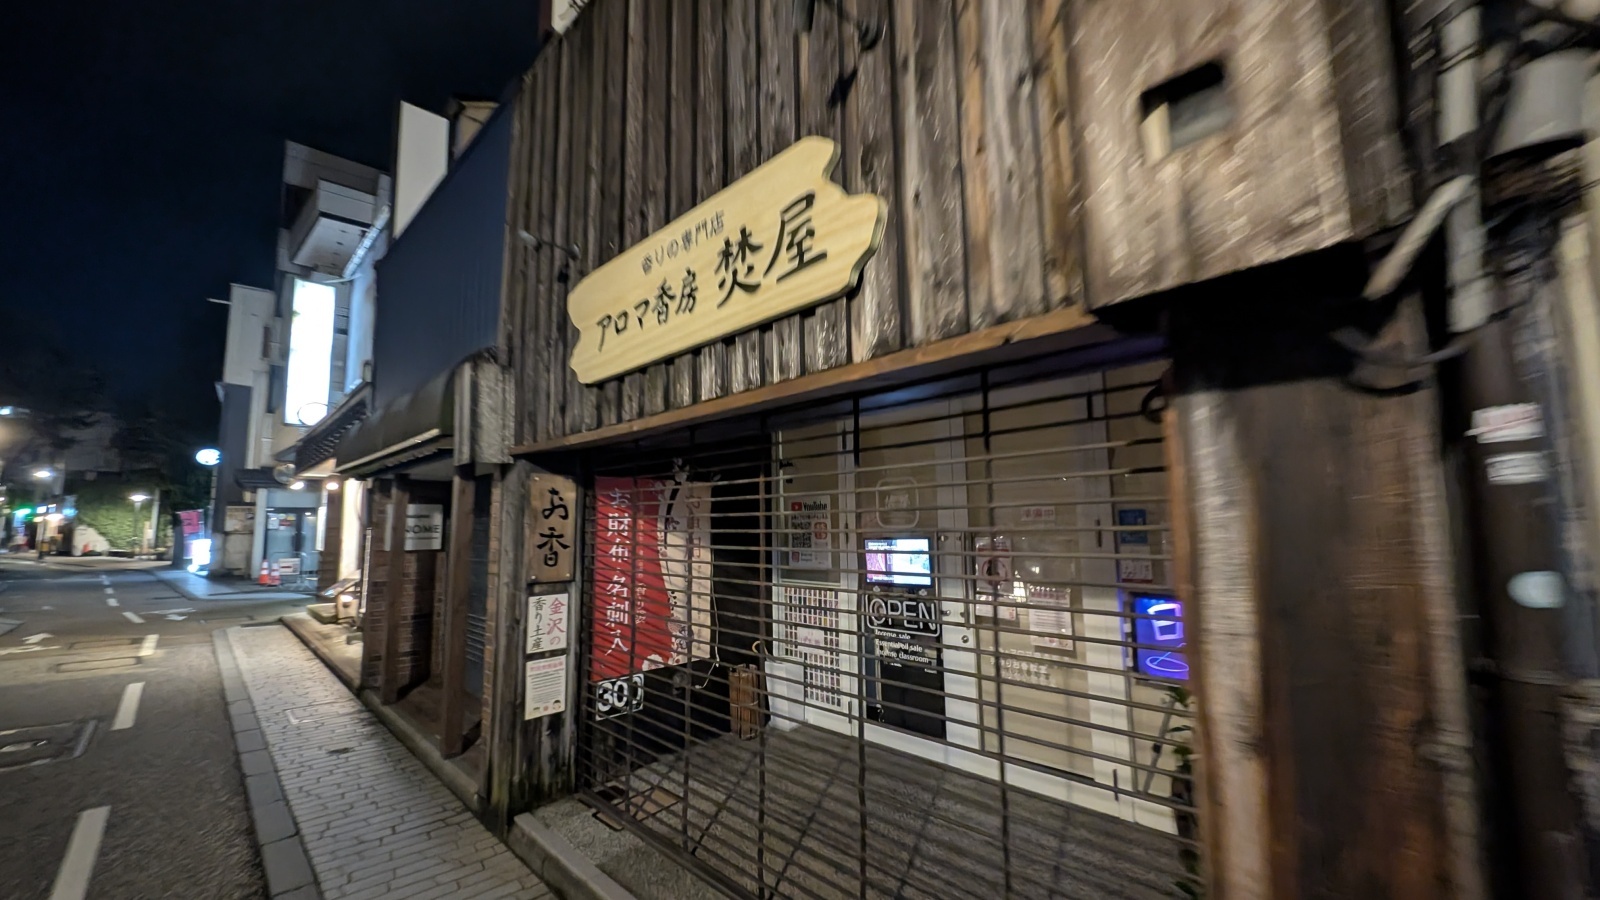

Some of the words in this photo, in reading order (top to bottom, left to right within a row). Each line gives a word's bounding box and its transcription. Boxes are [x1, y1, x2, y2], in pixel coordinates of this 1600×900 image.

[596, 267, 699, 353] アロマ香房
[714, 189, 828, 310] 焚屋
[803, 501, 828, 511] YouTube
[537, 487, 570, 567] お香
[529, 597, 547, 652] 香り土産
[547, 597, 567, 646] 金沢の
[870, 599, 936, 630] OPEN
[899, 651, 929, 663] classroom
[909, 644, 922, 652] sale
